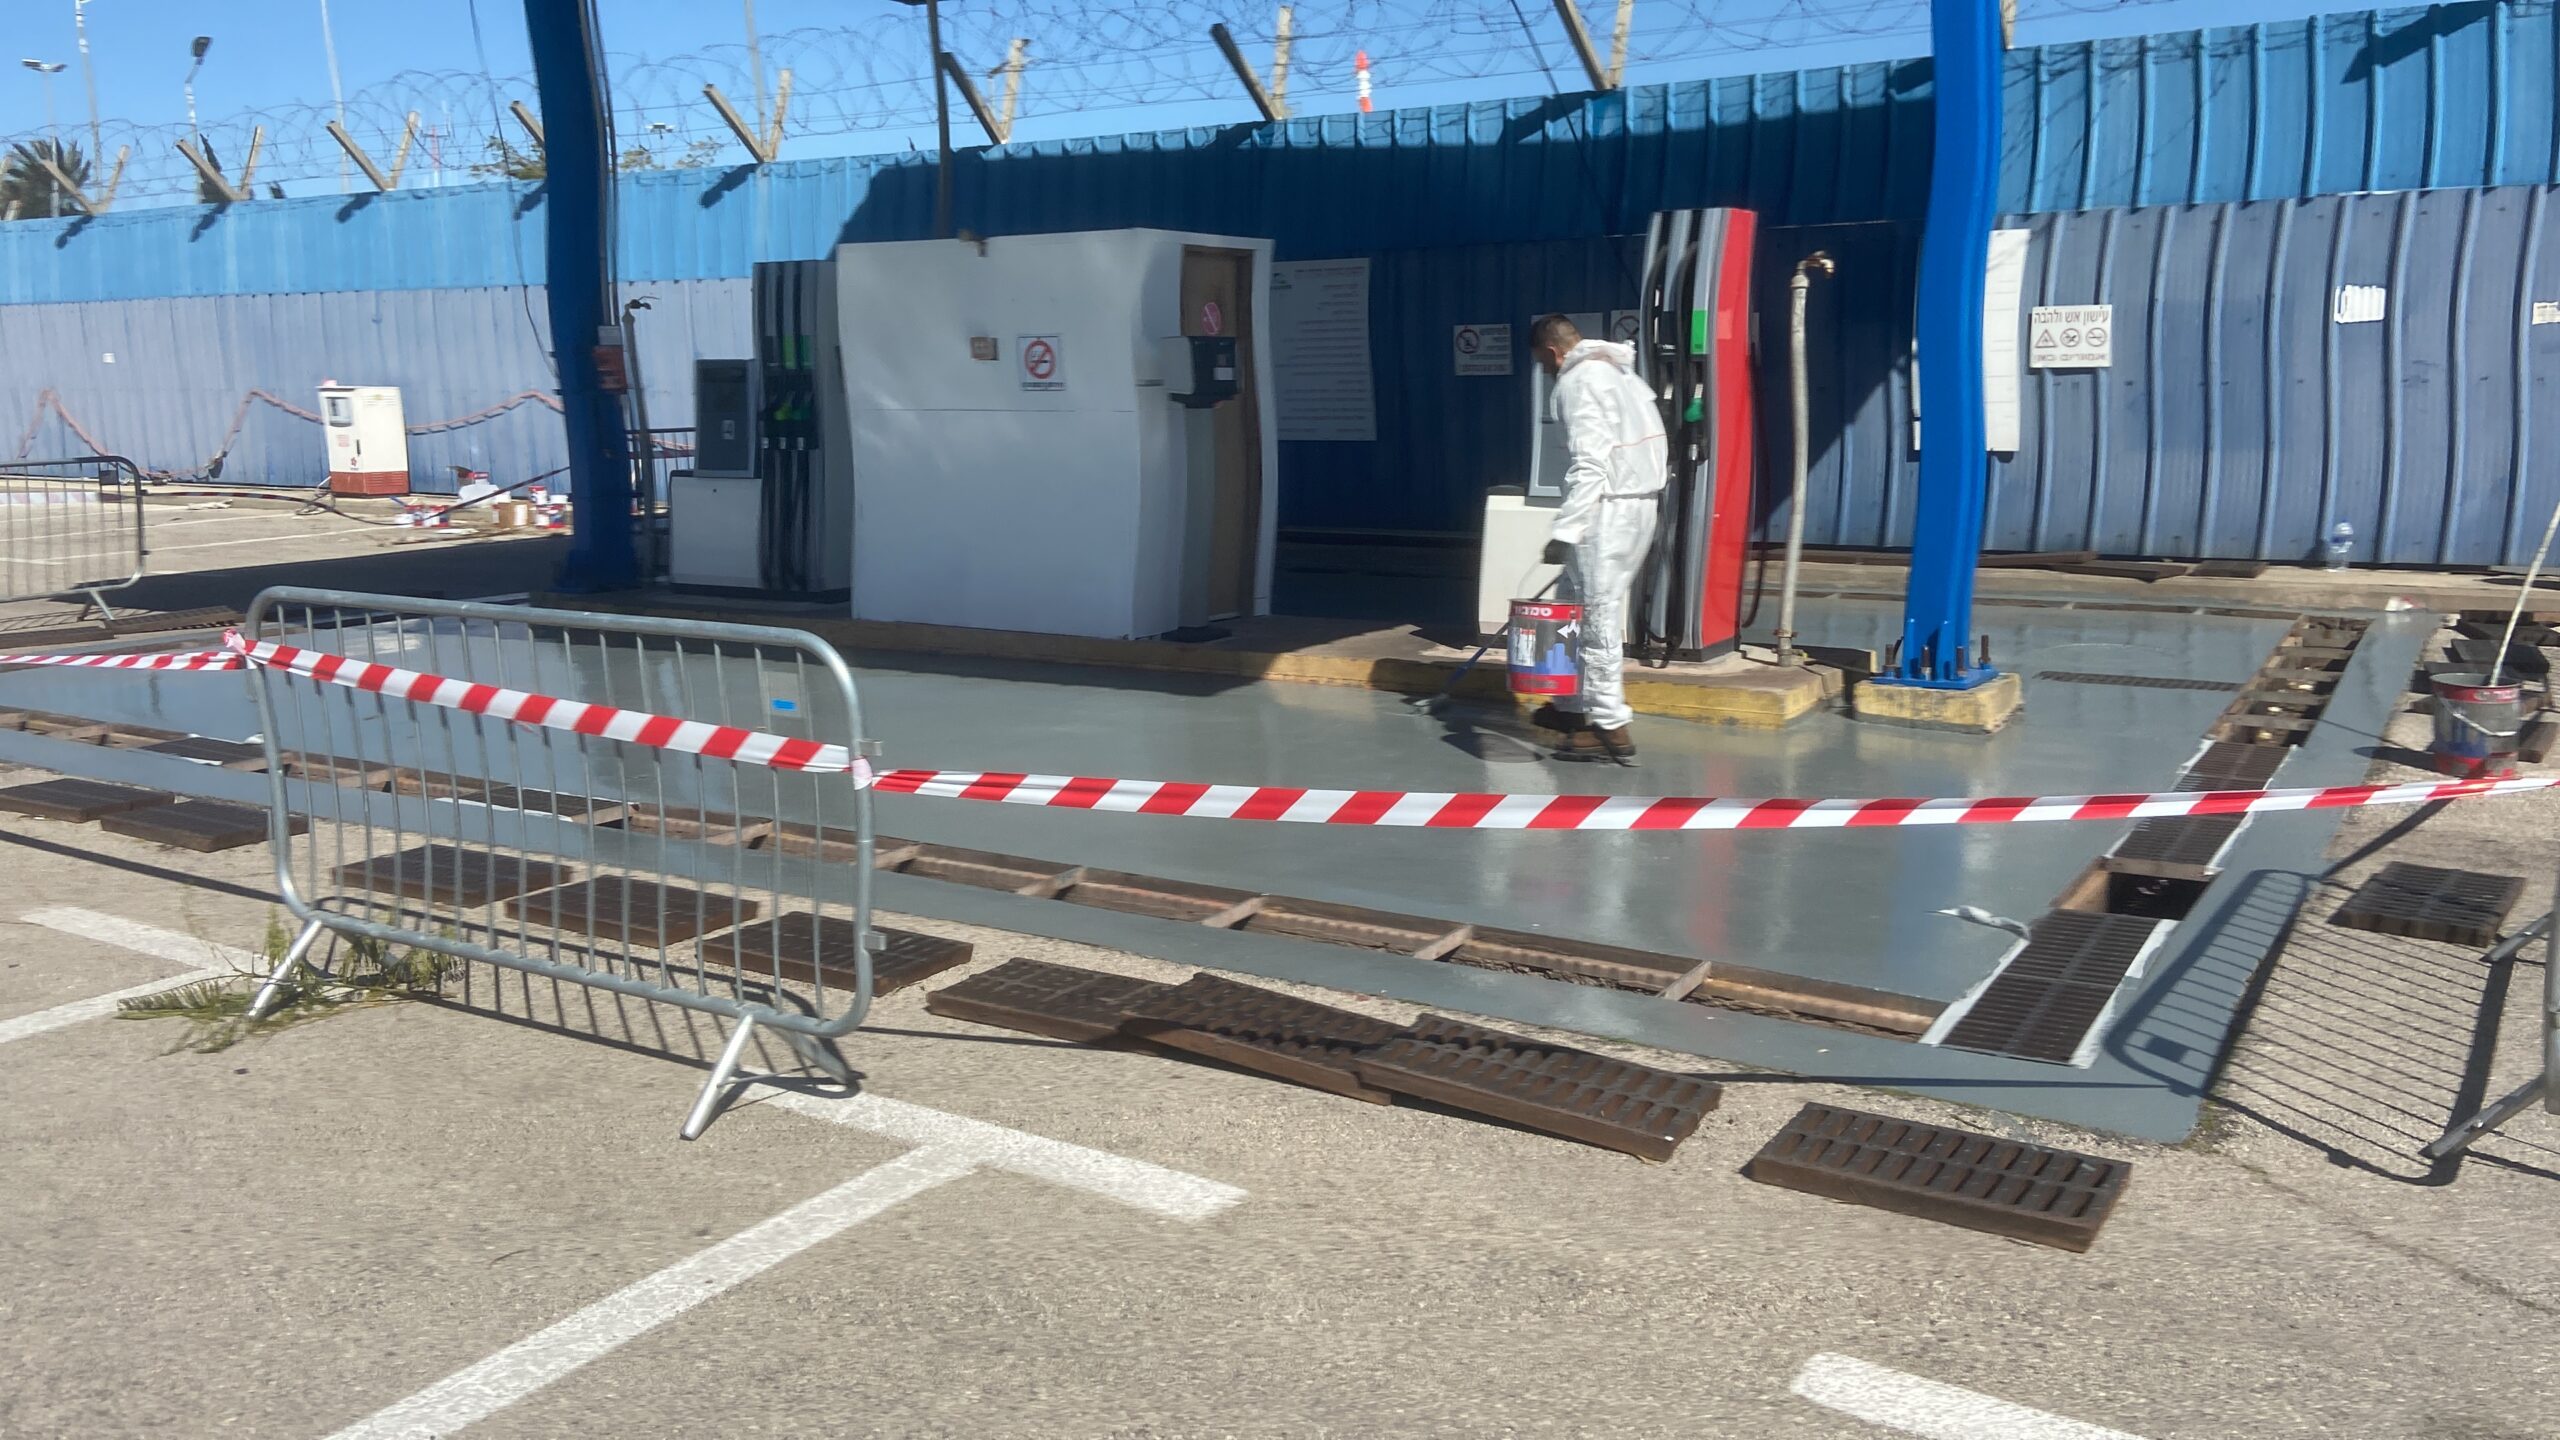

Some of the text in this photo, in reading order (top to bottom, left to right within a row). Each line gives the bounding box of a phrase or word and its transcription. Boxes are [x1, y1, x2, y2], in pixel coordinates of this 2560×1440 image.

[2034, 309, 2109, 325] עישון אש ולהבה
